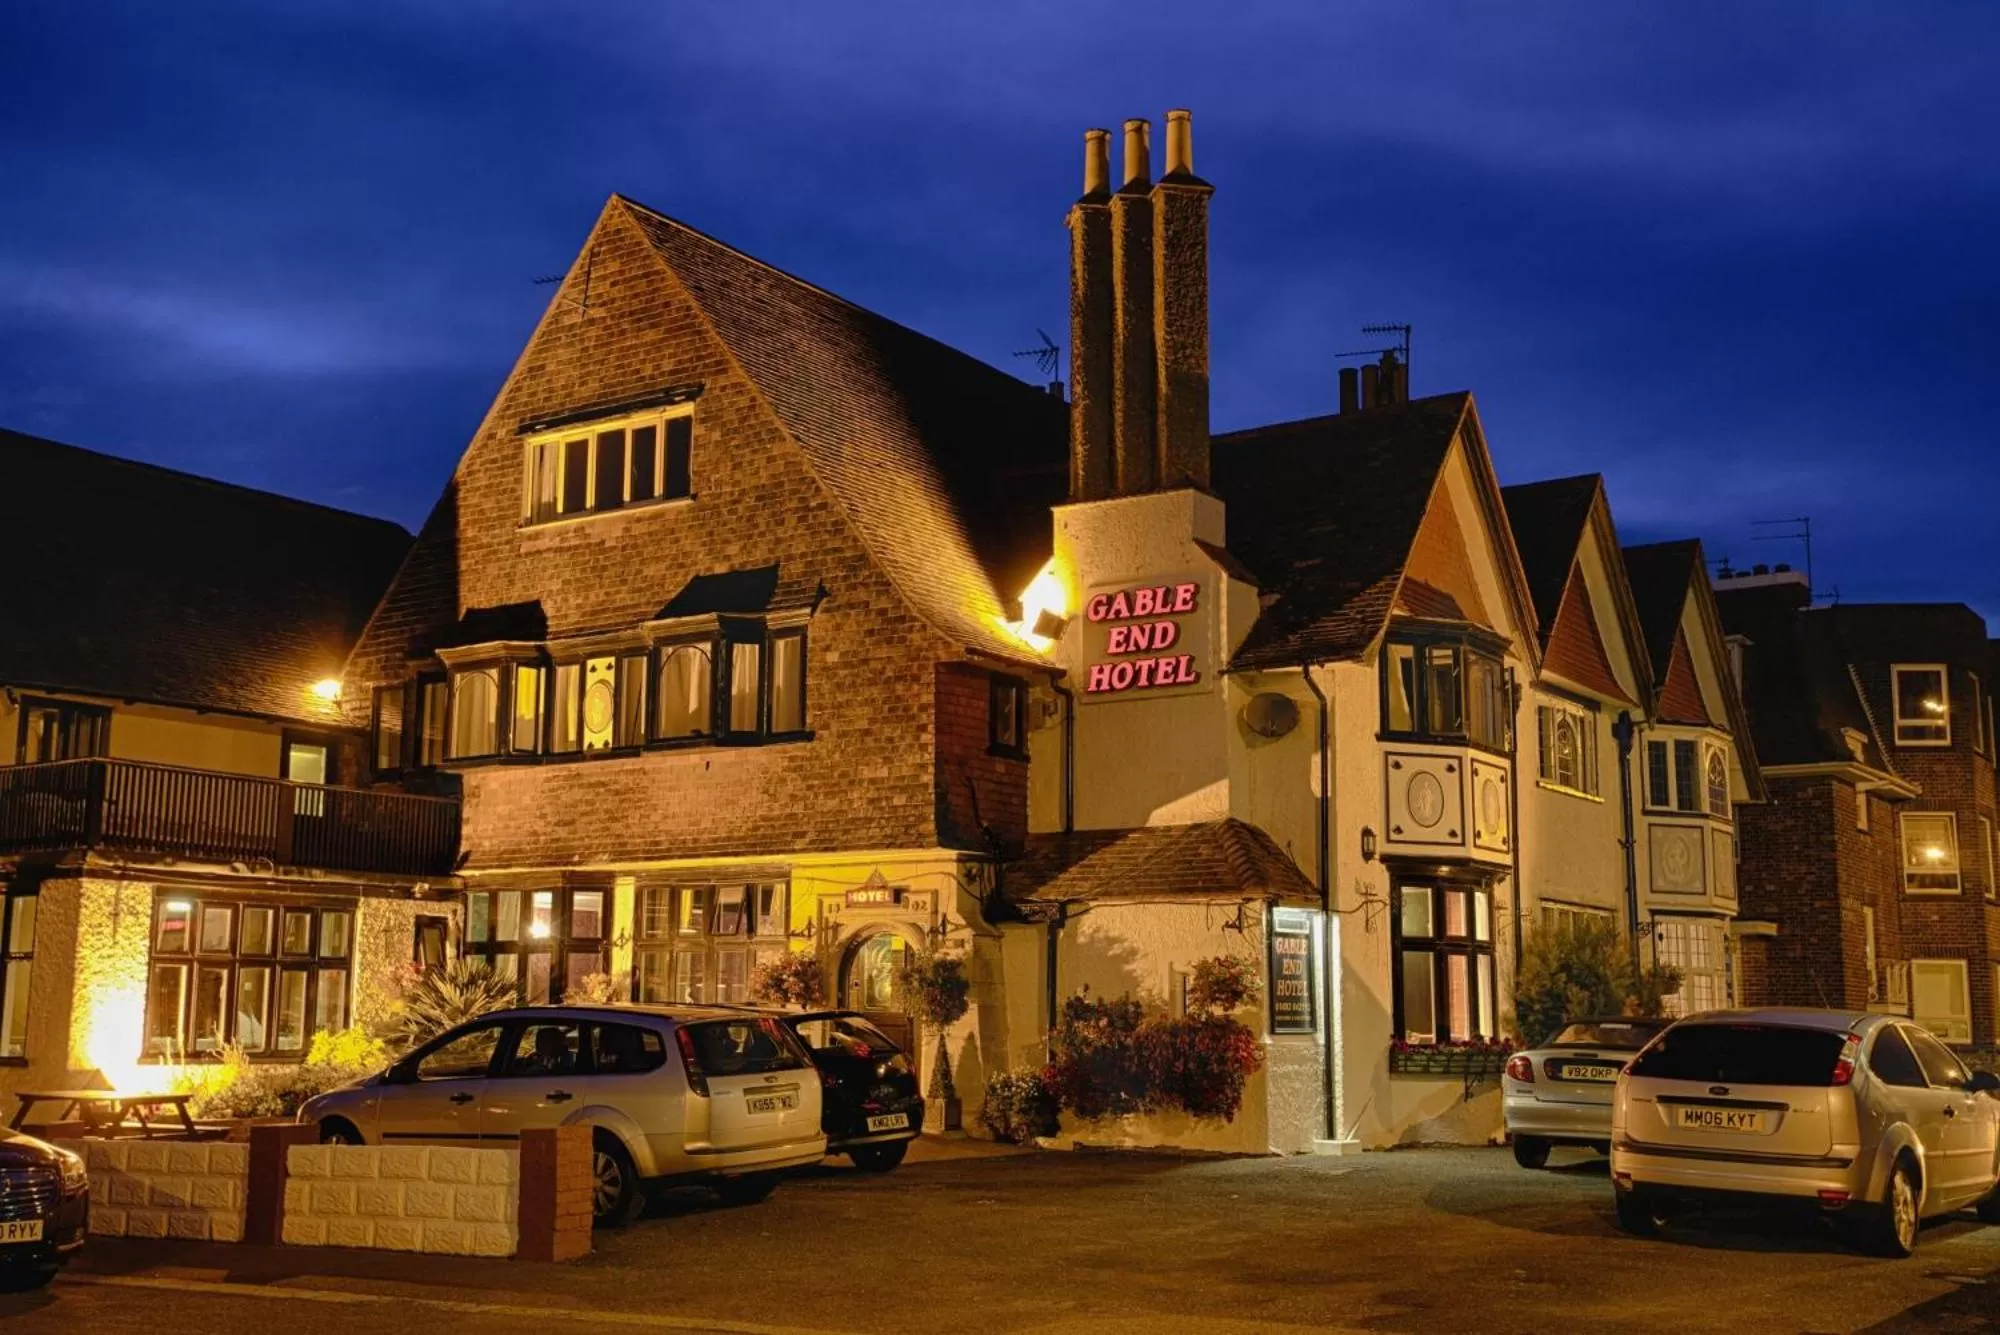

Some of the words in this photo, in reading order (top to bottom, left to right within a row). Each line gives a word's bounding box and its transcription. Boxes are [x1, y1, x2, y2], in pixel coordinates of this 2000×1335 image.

[1087, 583, 1196, 622] GABLE
[1106, 621, 1176, 655] END
[1087, 655, 1197, 692] HOTEL
[848, 890, 891, 903] HOTEL
[1276, 937, 1308, 955] GABLE
[1282, 958, 1302, 976] END
[1276, 980, 1309, 997] HOTEL
[1727, 1111, 1757, 1128] KYT
